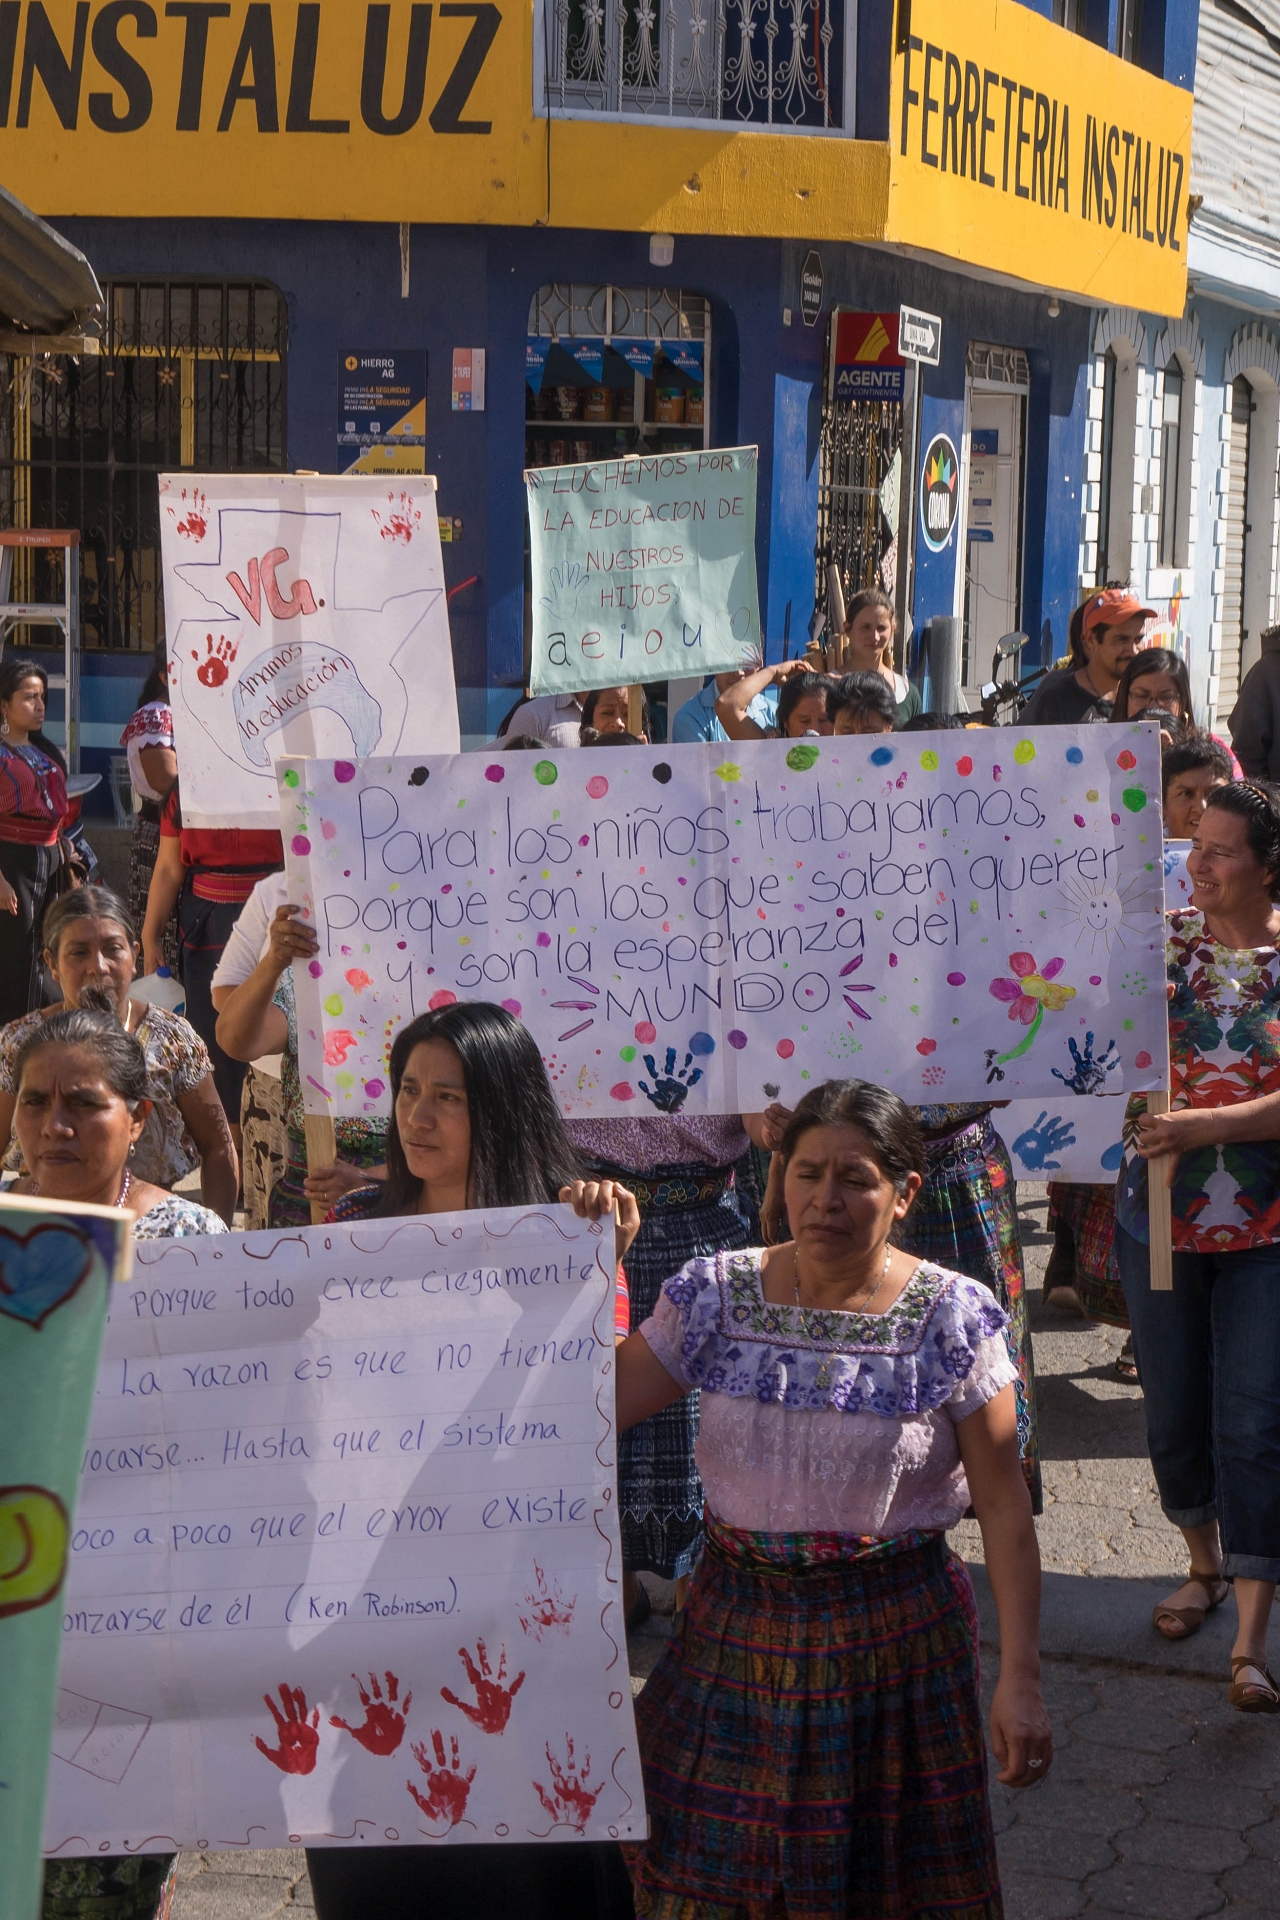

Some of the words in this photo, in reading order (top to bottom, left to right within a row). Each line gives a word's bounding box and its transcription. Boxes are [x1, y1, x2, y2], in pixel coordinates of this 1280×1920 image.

[0, 0, 502, 135] INSTALUZ
[899, 35, 1070, 214] FERRETERIA
[1081, 113, 1184, 252] INSTALUZ
[361, 359, 394, 368] HIERRO
[376, 386, 410, 394] SEGURIDAD
[382, 369, 394, 378] AG
[837, 370, 900, 387] AGENTE
[376, 398, 410, 406] SEGURIDAD
[853, 388, 900, 397] CONTINENTAL
[552, 457, 687, 494] LUCHEMOS
[698, 454, 733, 475] POR
[543, 508, 575, 531] LA
[589, 499, 705, 529] EDUCACION
[718, 497, 745, 519] DE
[586, 545, 684, 572] NUESTROS
[600, 584, 671, 611] HIJOS
[238, 643, 303, 707] Amamos
[239, 720, 262, 740] la
[261, 654, 349, 730] educación
[358, 786, 479, 882] Para
[507, 796, 573, 868] los
[592, 804, 730, 860] niños
[752, 779, 1047, 862] trabajamos,
[322, 892, 489, 957] porque
[504, 883, 581, 923] son
[602, 872, 669, 921] los
[693, 872, 782, 941] que
[808, 851, 957, 904] saben
[969, 844, 1125, 921] querer
[386, 960, 416, 1018] y
[455, 948, 539, 988] son
[557, 933, 593, 974] la
[613, 917, 866, 990] esperanza
[891, 898, 960, 947] del
[606, 971, 831, 1024] MUNDO
[235, 1278, 295, 1310] todo
[323, 1274, 400, 1302] cree
[421, 1254, 594, 1297] ciegamente
[121, 1357, 162, 1397] La
[182, 1358, 269, 1390] razon
[294, 1354, 333, 1382] es
[354, 1348, 409, 1377] que
[437, 1343, 472, 1372] no
[499, 1335, 596, 1368] tienen
[222, 1428, 311, 1465] Hasta
[332, 1427, 381, 1460] que
[399, 1419, 426, 1452] el
[443, 1412, 562, 1448] sistema
[71, 1528, 115, 1552] oco
[134, 1527, 155, 1546] a
[172, 1523, 232, 1552] poco
[250, 1511, 307, 1547] que
[317, 1502, 346, 1537] el
[366, 1503, 451, 1539] error
[481, 1488, 588, 1530] existe
[61, 1607, 168, 1635] onzarse
[179, 1594, 213, 1627] de
[226, 1593, 252, 1626] él
